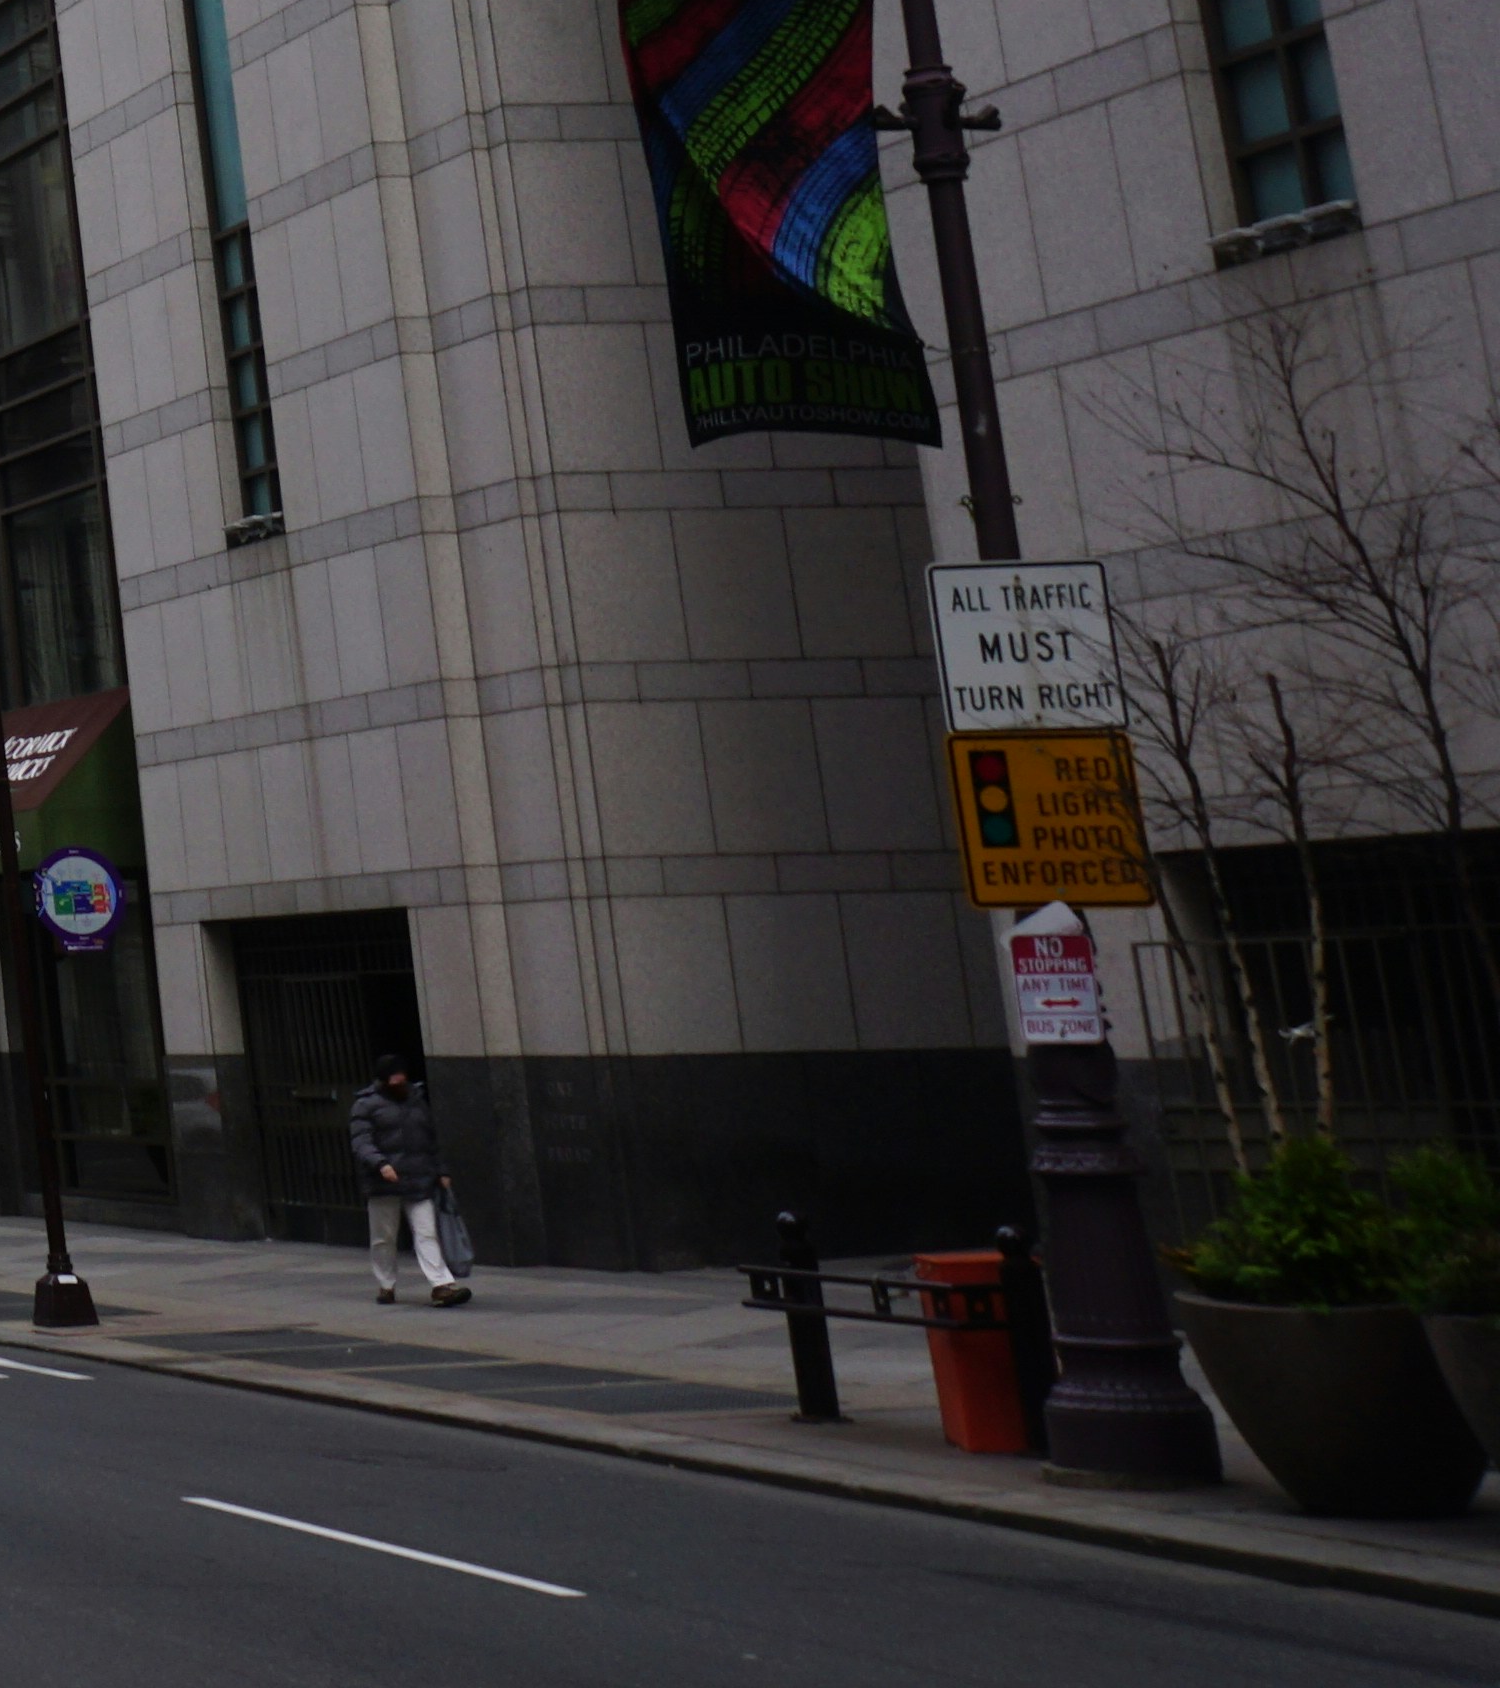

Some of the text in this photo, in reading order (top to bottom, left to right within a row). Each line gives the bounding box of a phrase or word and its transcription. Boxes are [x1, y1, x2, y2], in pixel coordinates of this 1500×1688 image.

[686, 333, 917, 370] PHILADELPHIA
[688, 358, 923, 416] AUTO SHOW
[952, 582, 1092, 613] ALL TRAFFIC
[978, 631, 1073, 664] MUST
[954, 681, 1117, 713] TURN RIGHT
[1055, 757, 1112, 782] RED
[1037, 792, 1118, 817] LIGHT
[1033, 825, 1125, 851] PHOTO
[984, 859, 1138, 886] ENFORCED
[1033, 937, 1063, 958] NO
[1018, 957, 1087, 973] STOPPING
[1022, 978, 1089, 992] ANY TIME
[1026, 1019, 1095, 1034] BUS ZONE
